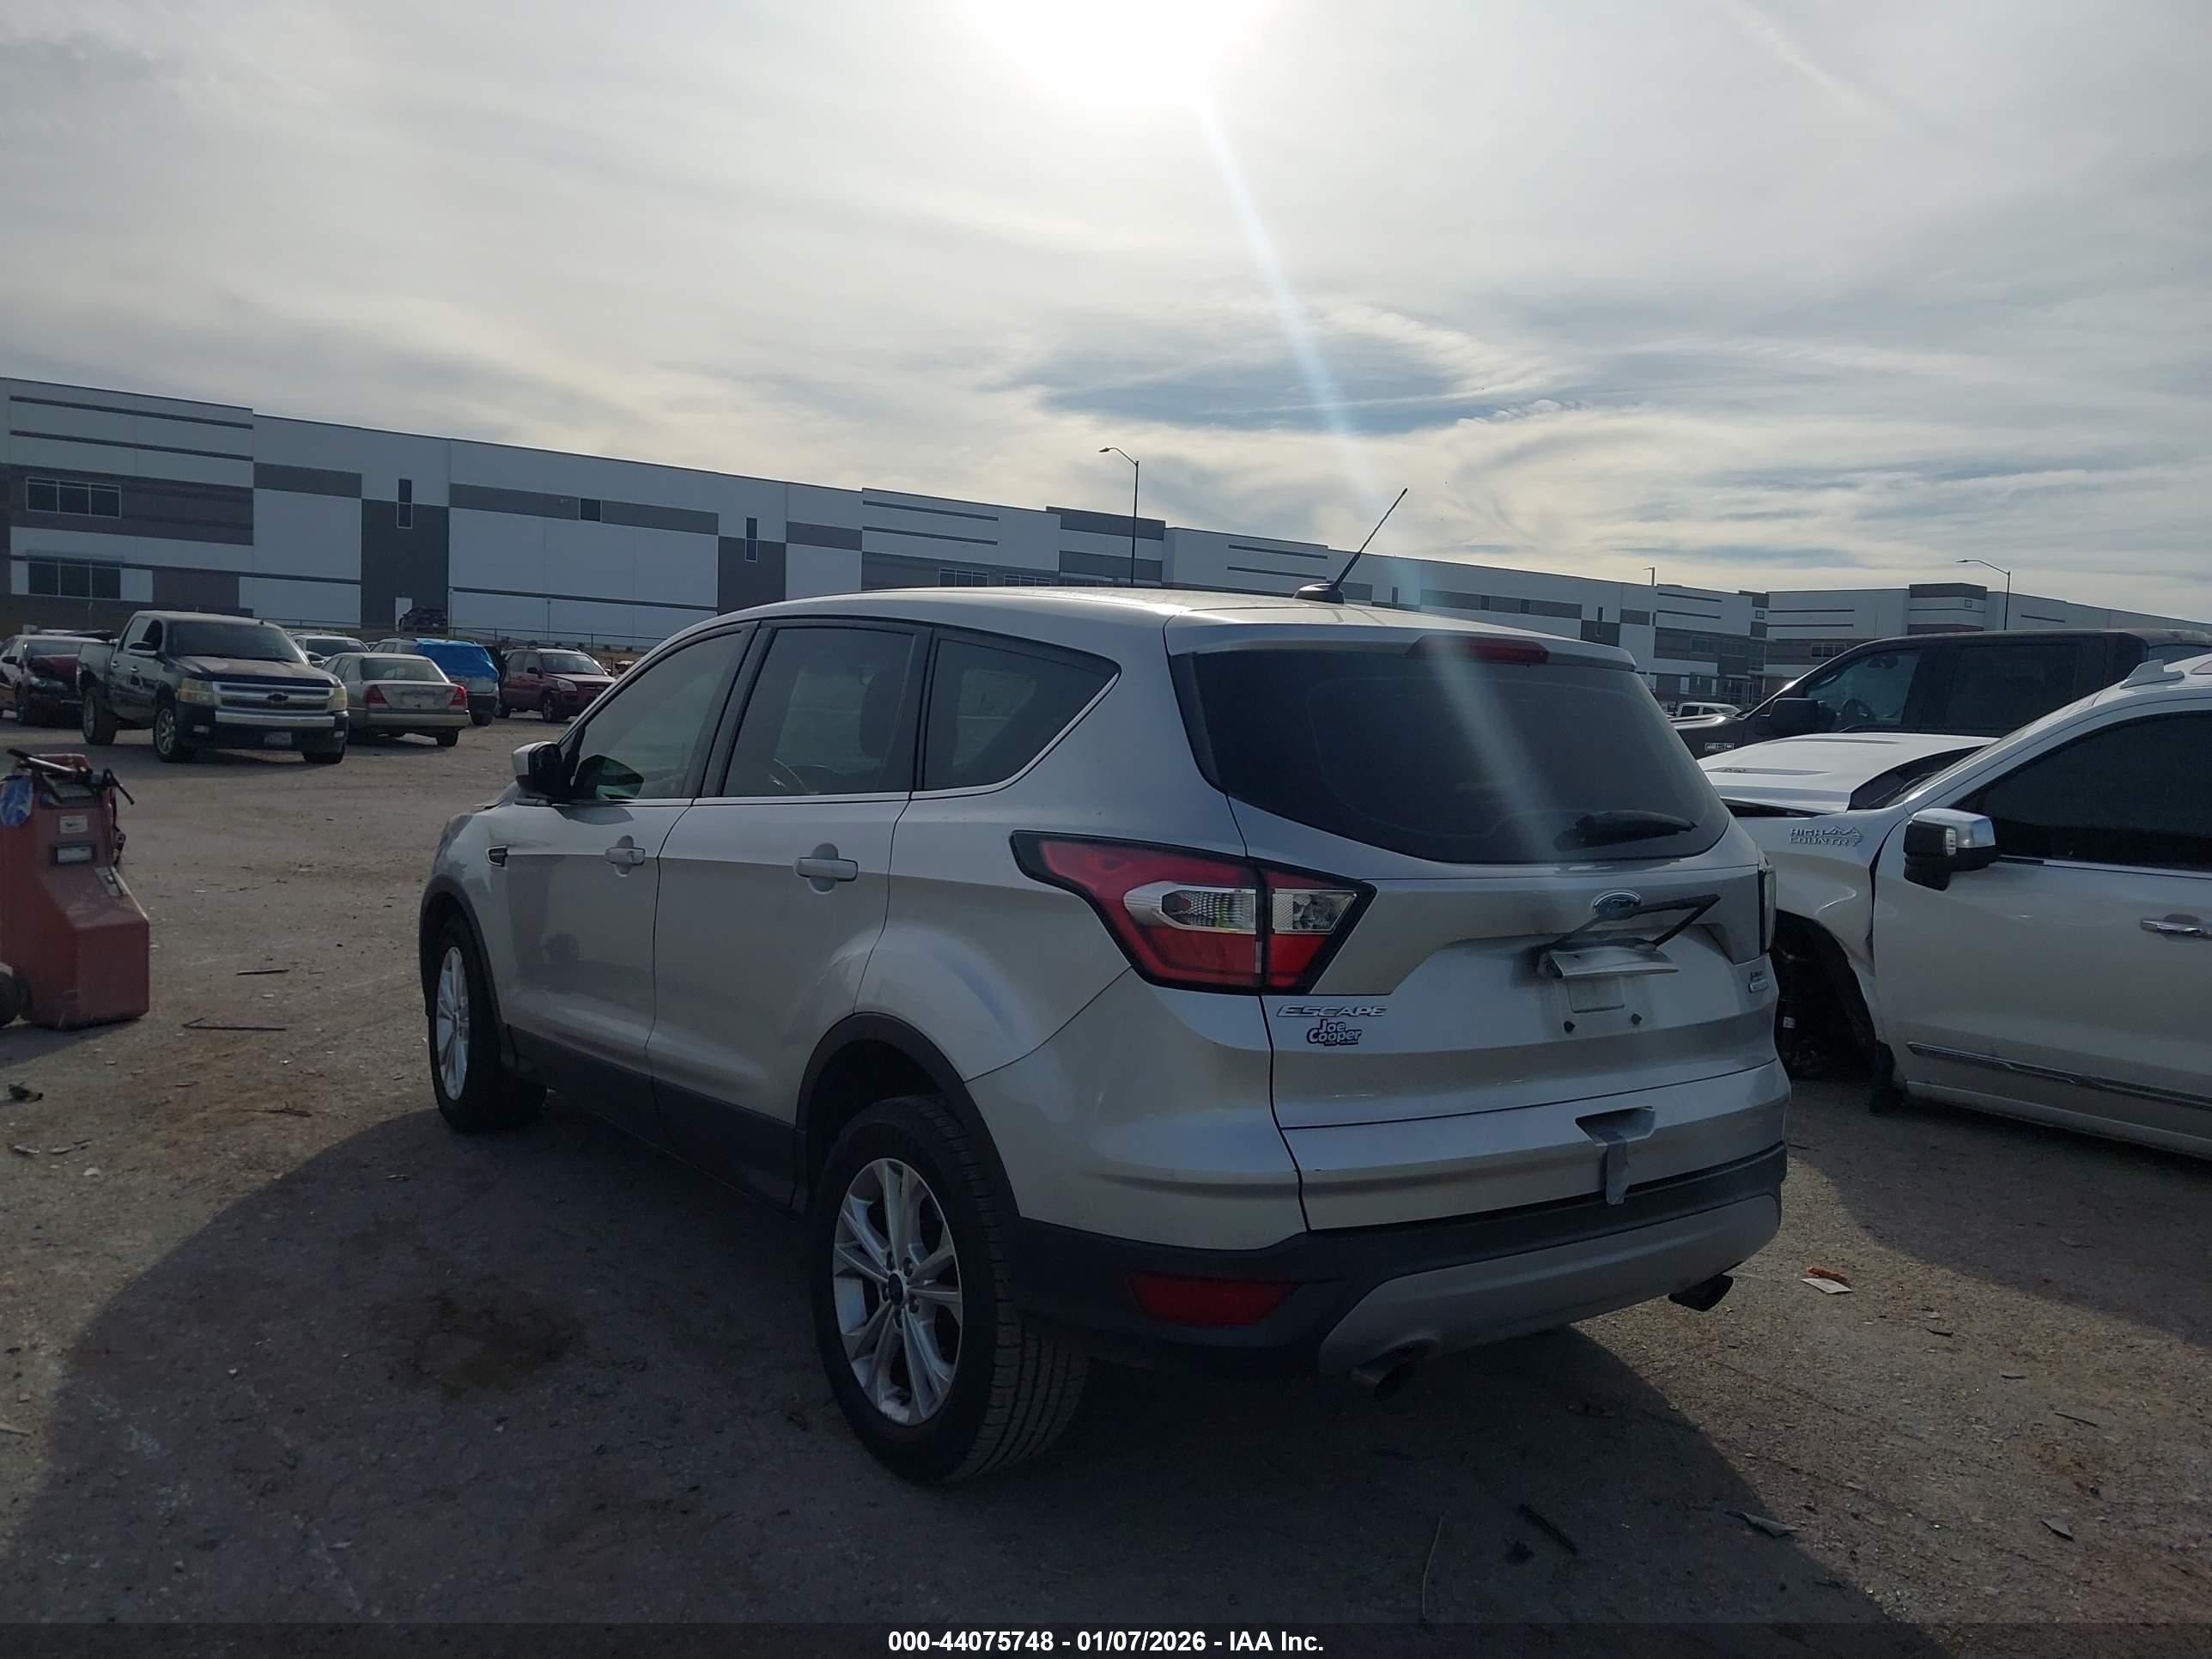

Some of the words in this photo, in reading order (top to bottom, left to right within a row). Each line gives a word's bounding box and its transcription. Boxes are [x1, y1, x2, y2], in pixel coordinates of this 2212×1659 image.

[1790, 828, 1825, 836] HIGH
[1790, 837, 1863, 847] COUNTRY
[1277, 1005, 1389, 1018] ESCAPE
[1318, 1018, 1346, 1032] Joe
[1307, 1028, 1362, 1043] Cooper
